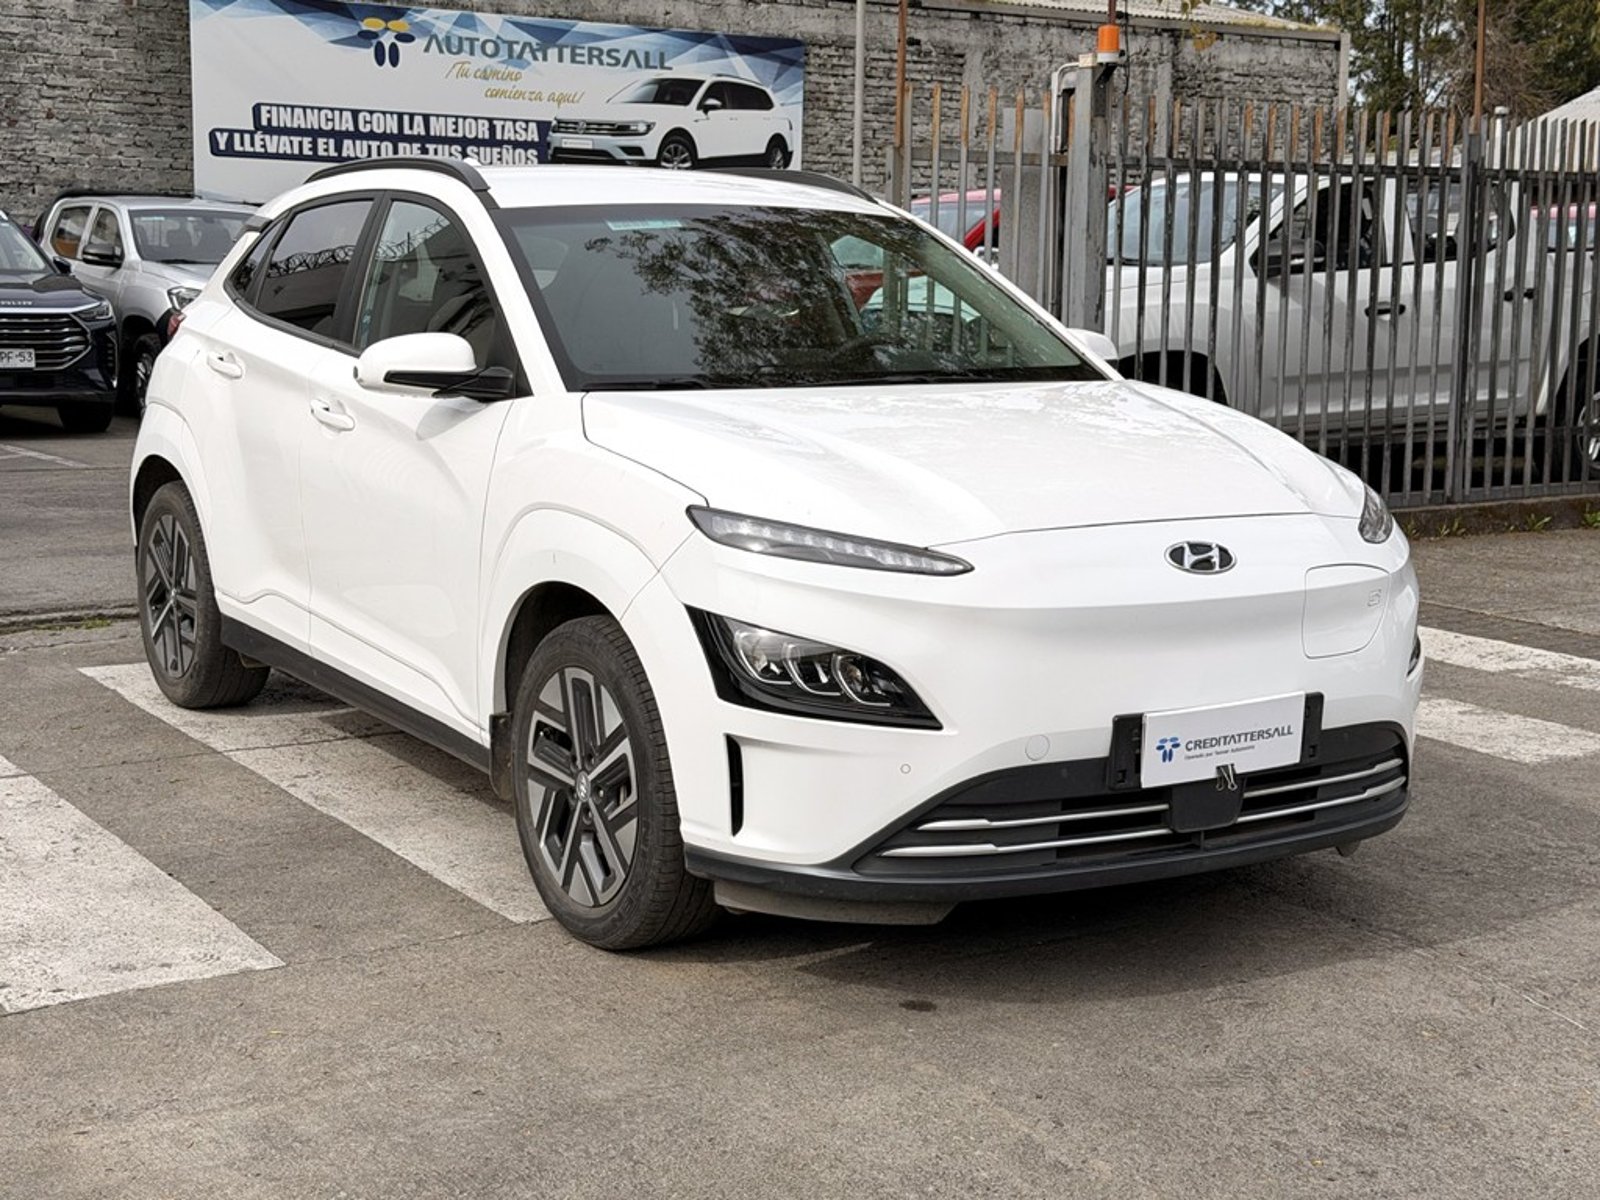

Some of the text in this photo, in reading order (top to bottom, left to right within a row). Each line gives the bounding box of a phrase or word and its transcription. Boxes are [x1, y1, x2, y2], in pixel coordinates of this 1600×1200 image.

[423, 33, 673, 71] AUTOTATTERSALL
[473, 65, 523, 82] camino
[484, 84, 544, 102] comienza
[260, 105, 540, 143] FINANCIA CON LA MEJOR TASA
[214, 131, 538, 166] Y LLÉVATE EL AUTO DE TUS SUEÑOS
[1185, 725, 1294, 752] CREDITATTERSALL
